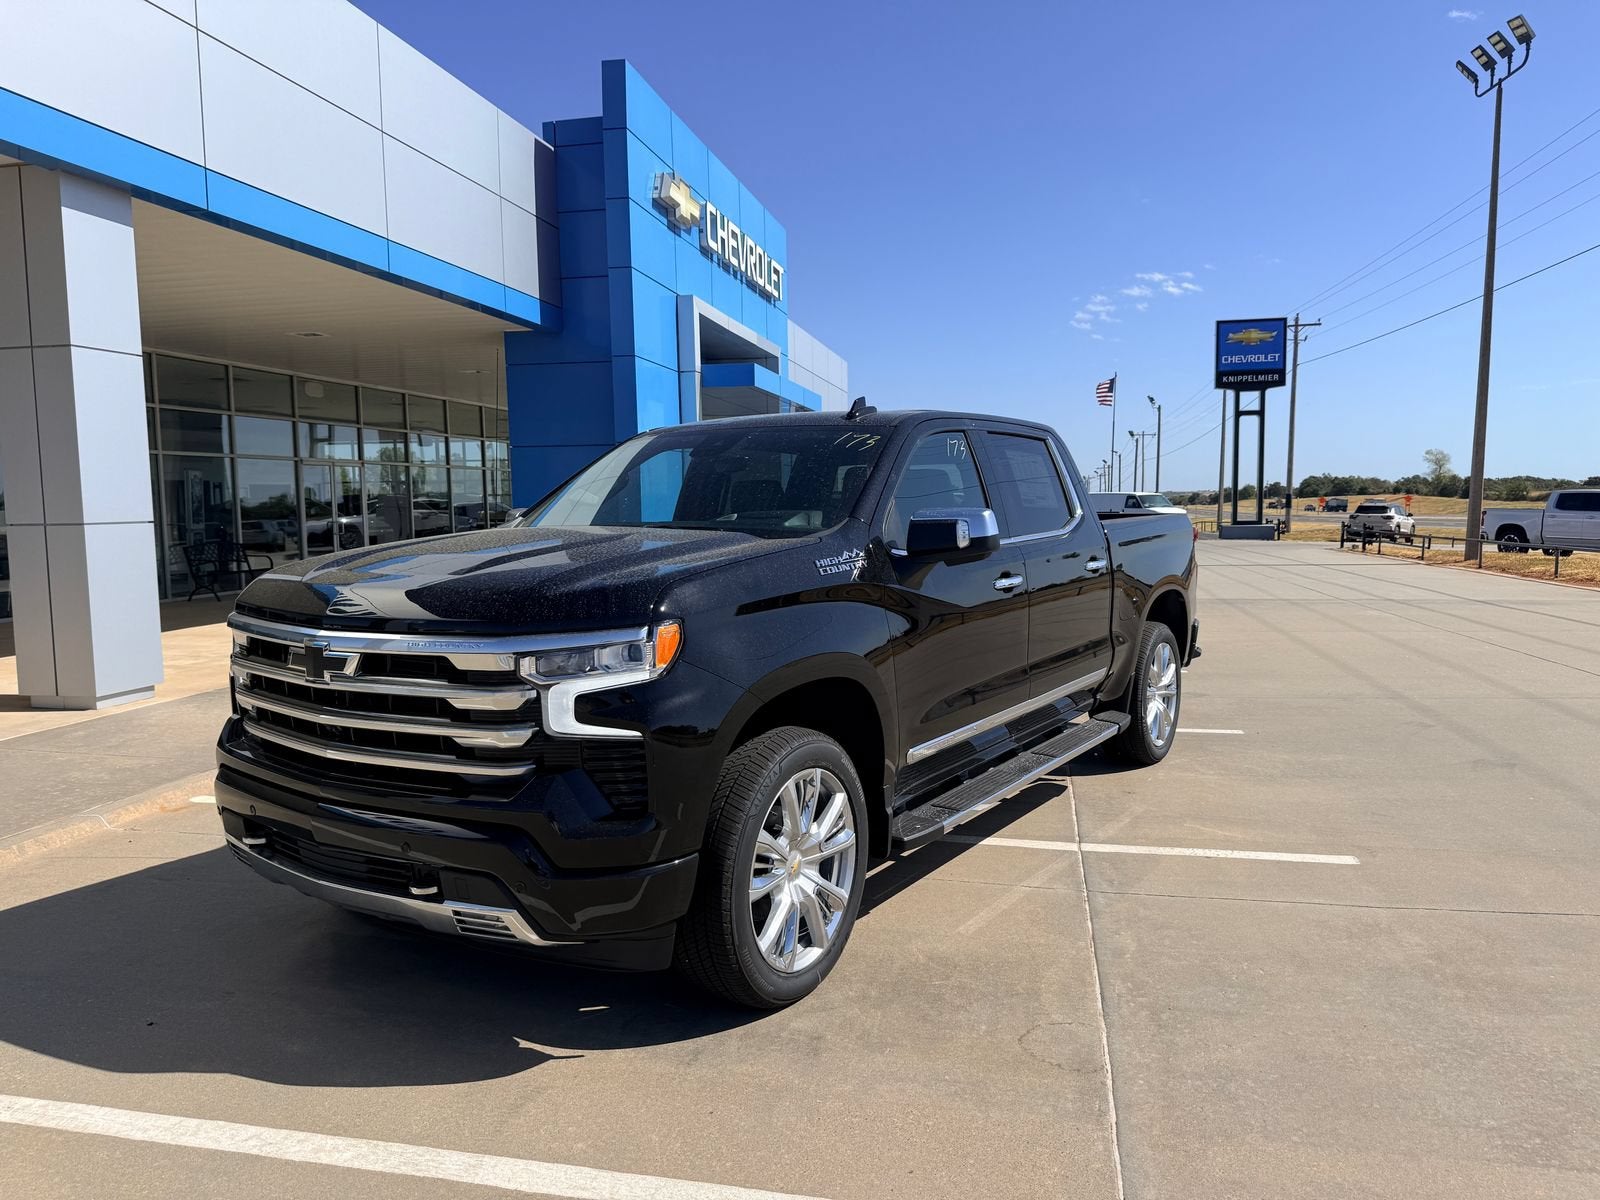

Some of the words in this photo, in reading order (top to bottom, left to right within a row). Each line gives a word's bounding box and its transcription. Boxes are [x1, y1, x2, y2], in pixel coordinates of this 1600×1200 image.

[705, 200, 784, 301] CHEVROLET
[1221, 353, 1280, 364] CHEVROLET
[1222, 374, 1279, 383] KNIPPELMIER
[833, 431, 881, 451] 173
[947, 437, 966, 460] 173
[814, 556, 842, 568] HIGH
[819, 559, 868, 576] COUNTRY
